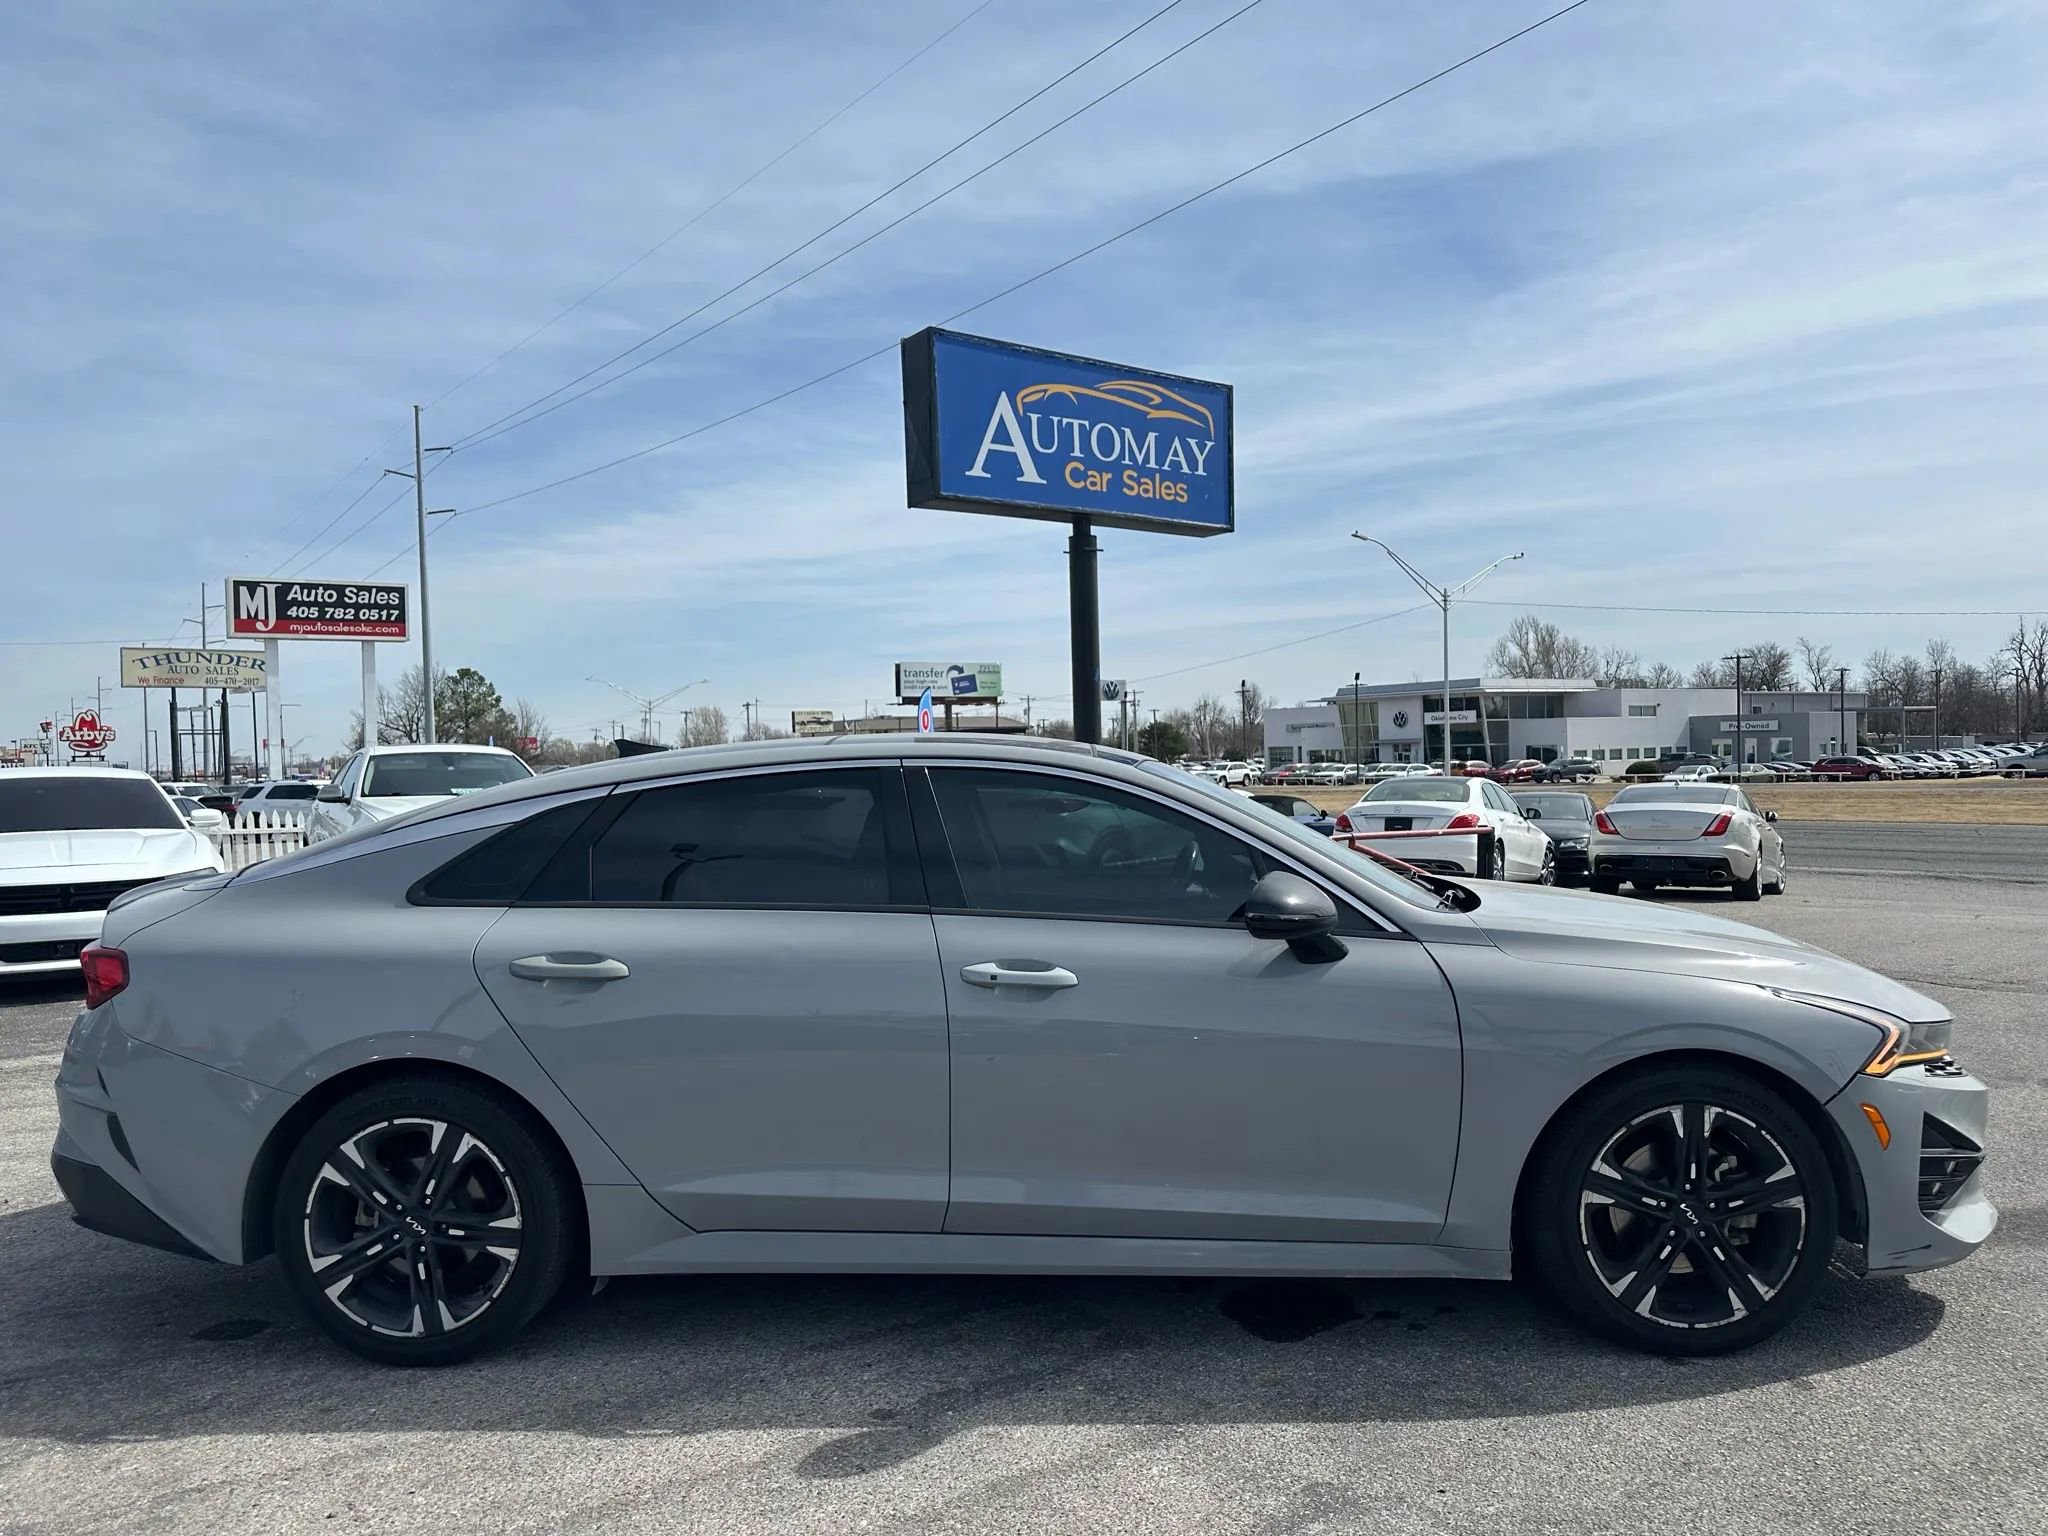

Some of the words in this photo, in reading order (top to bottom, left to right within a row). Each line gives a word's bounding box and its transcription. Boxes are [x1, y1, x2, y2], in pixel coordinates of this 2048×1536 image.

[965, 391, 1215, 484] AUTOMAY
[1064, 461, 1113, 492] Car
[1122, 470, 1188, 503] Sales
[287, 585, 337, 603] Auto
[344, 587, 400, 605] Sales
[239, 583, 282, 631] MJ
[287, 606, 318, 618] 405
[325, 608, 355, 619] 782
[359, 609, 399, 620] 0517
[290, 622, 399, 634] mjautosalesokc.com
[132, 652, 266, 672] THUNDER
[167, 665, 199, 674] AUTO
[205, 666, 239, 675] SALES
[137, 676, 150, 685] We
[153, 676, 184, 685] Finance
[204, 677, 260, 686] 405-470-2017
[904, 668, 945, 678] transfer
[61, 727, 115, 743] Arby's
